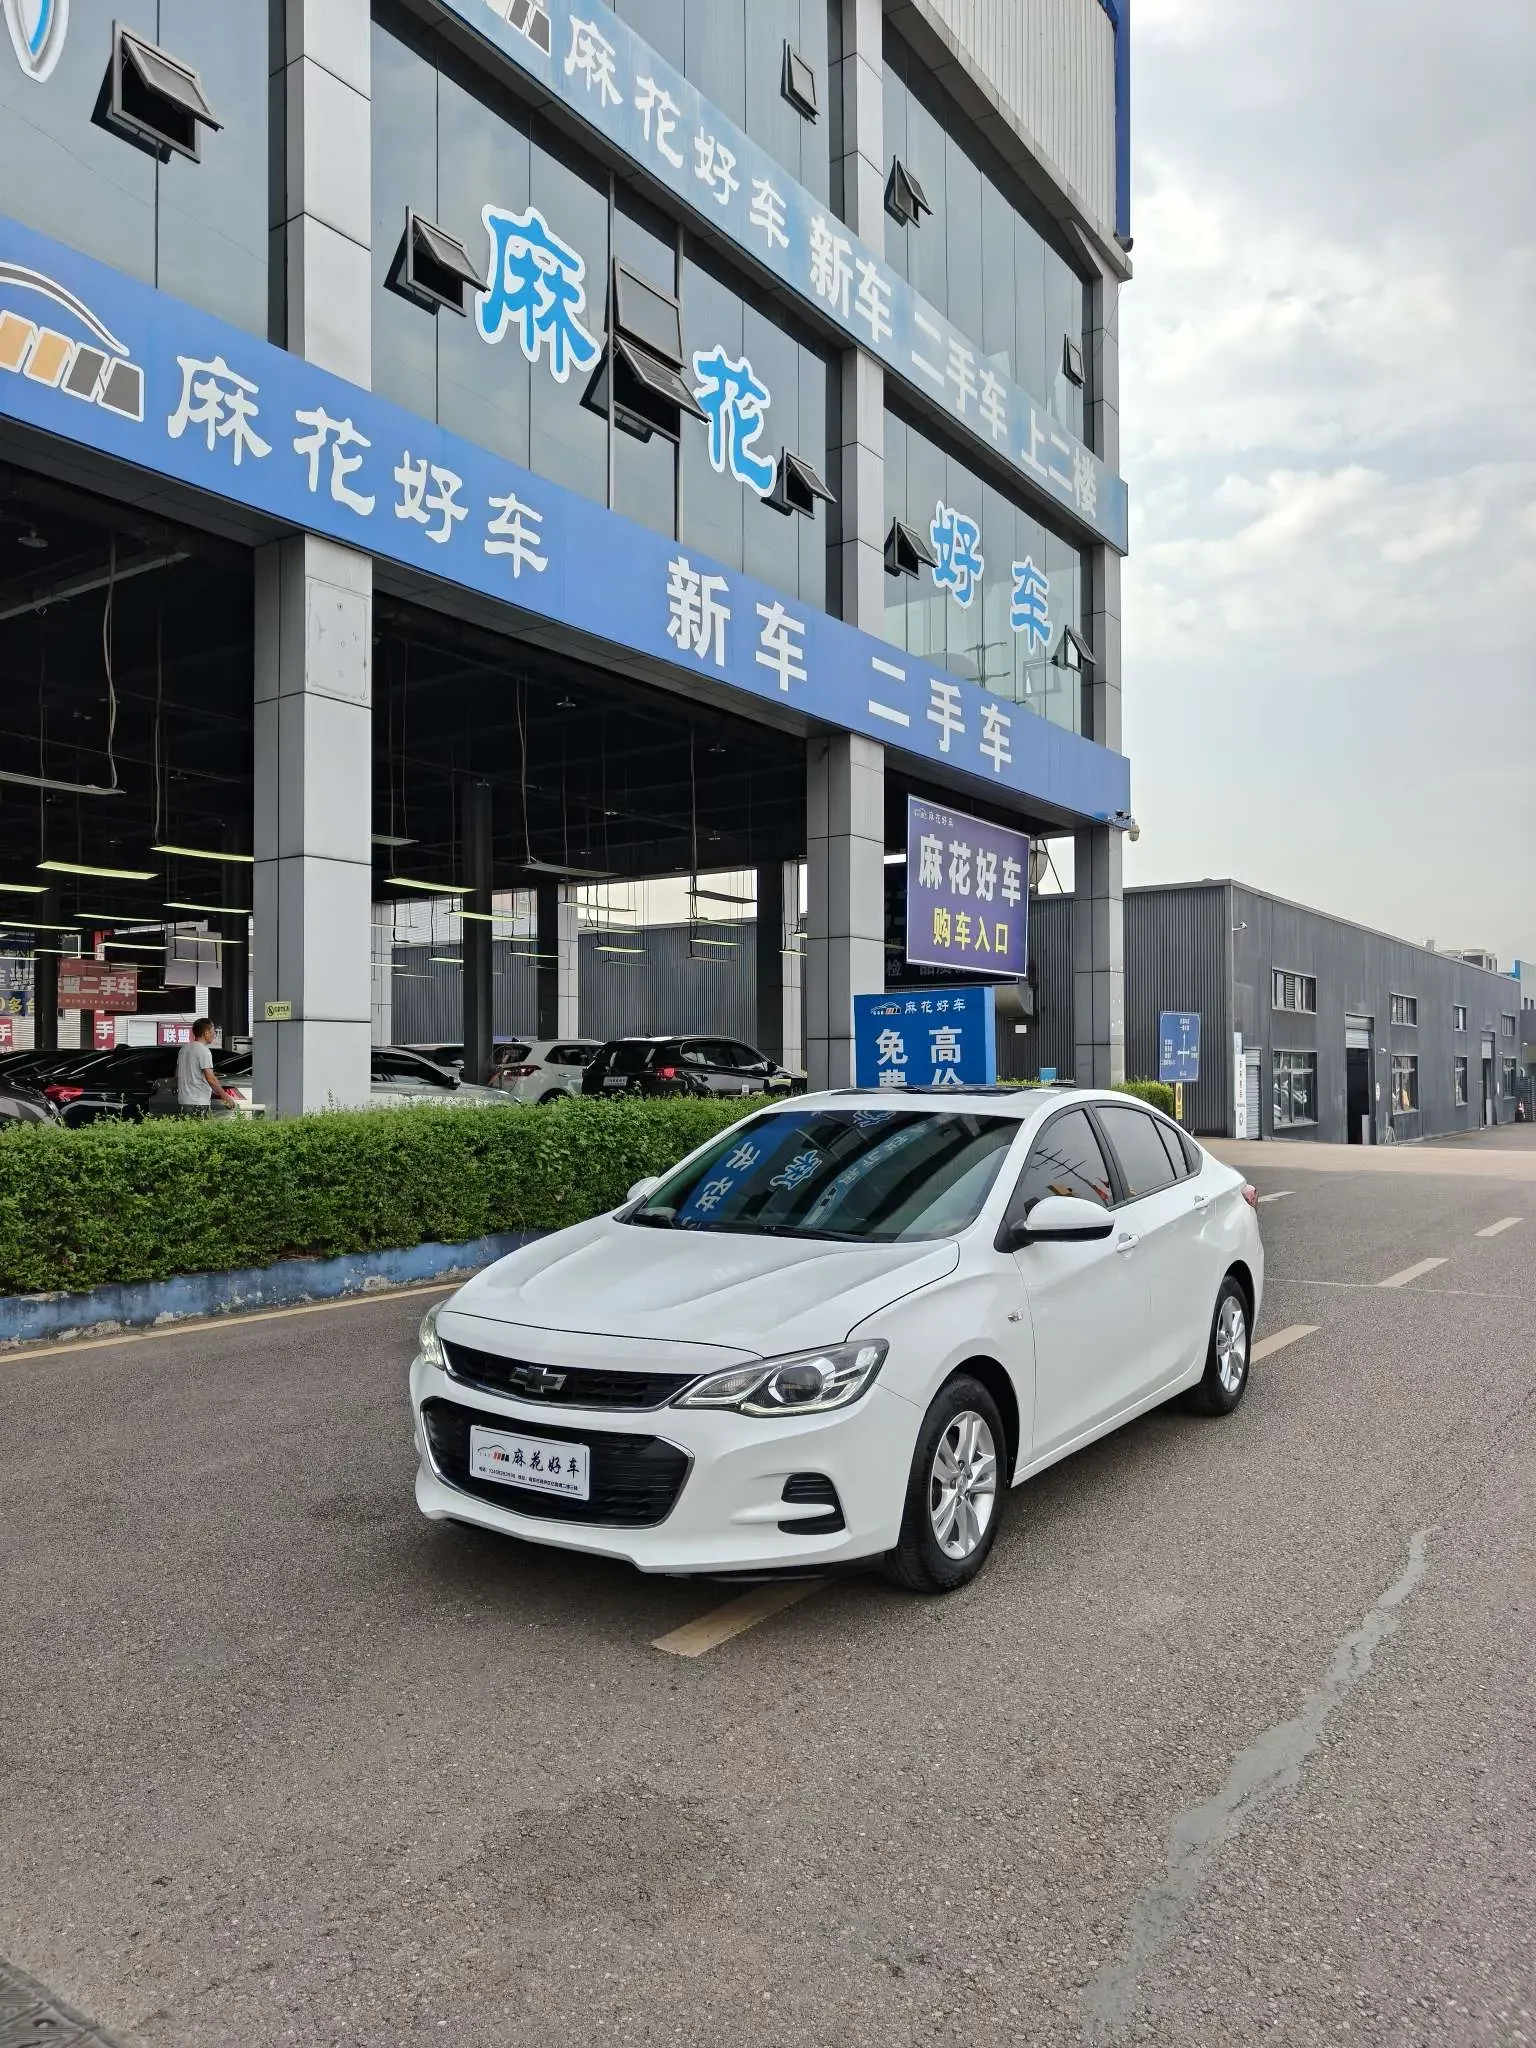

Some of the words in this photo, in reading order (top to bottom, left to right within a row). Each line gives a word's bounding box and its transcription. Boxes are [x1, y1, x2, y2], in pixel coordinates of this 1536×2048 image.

[565, 14, 790, 249] 麻花好车
[809, 213, 894, 342] 新车
[911, 309, 1008, 441] 二手车
[1020, 406, 1098, 521] 上二楼
[167, 354, 549, 579] 麻花好车
[665, 555, 808, 692] 新车
[868, 655, 1013, 773] 二手车
[918, 833, 1022, 907] 麻花好车
[932, 907, 1010, 955] 购车入口
[904, 998, 966, 1014] 麻花好车
[512, 1448, 580, 1480] 麻花好车
